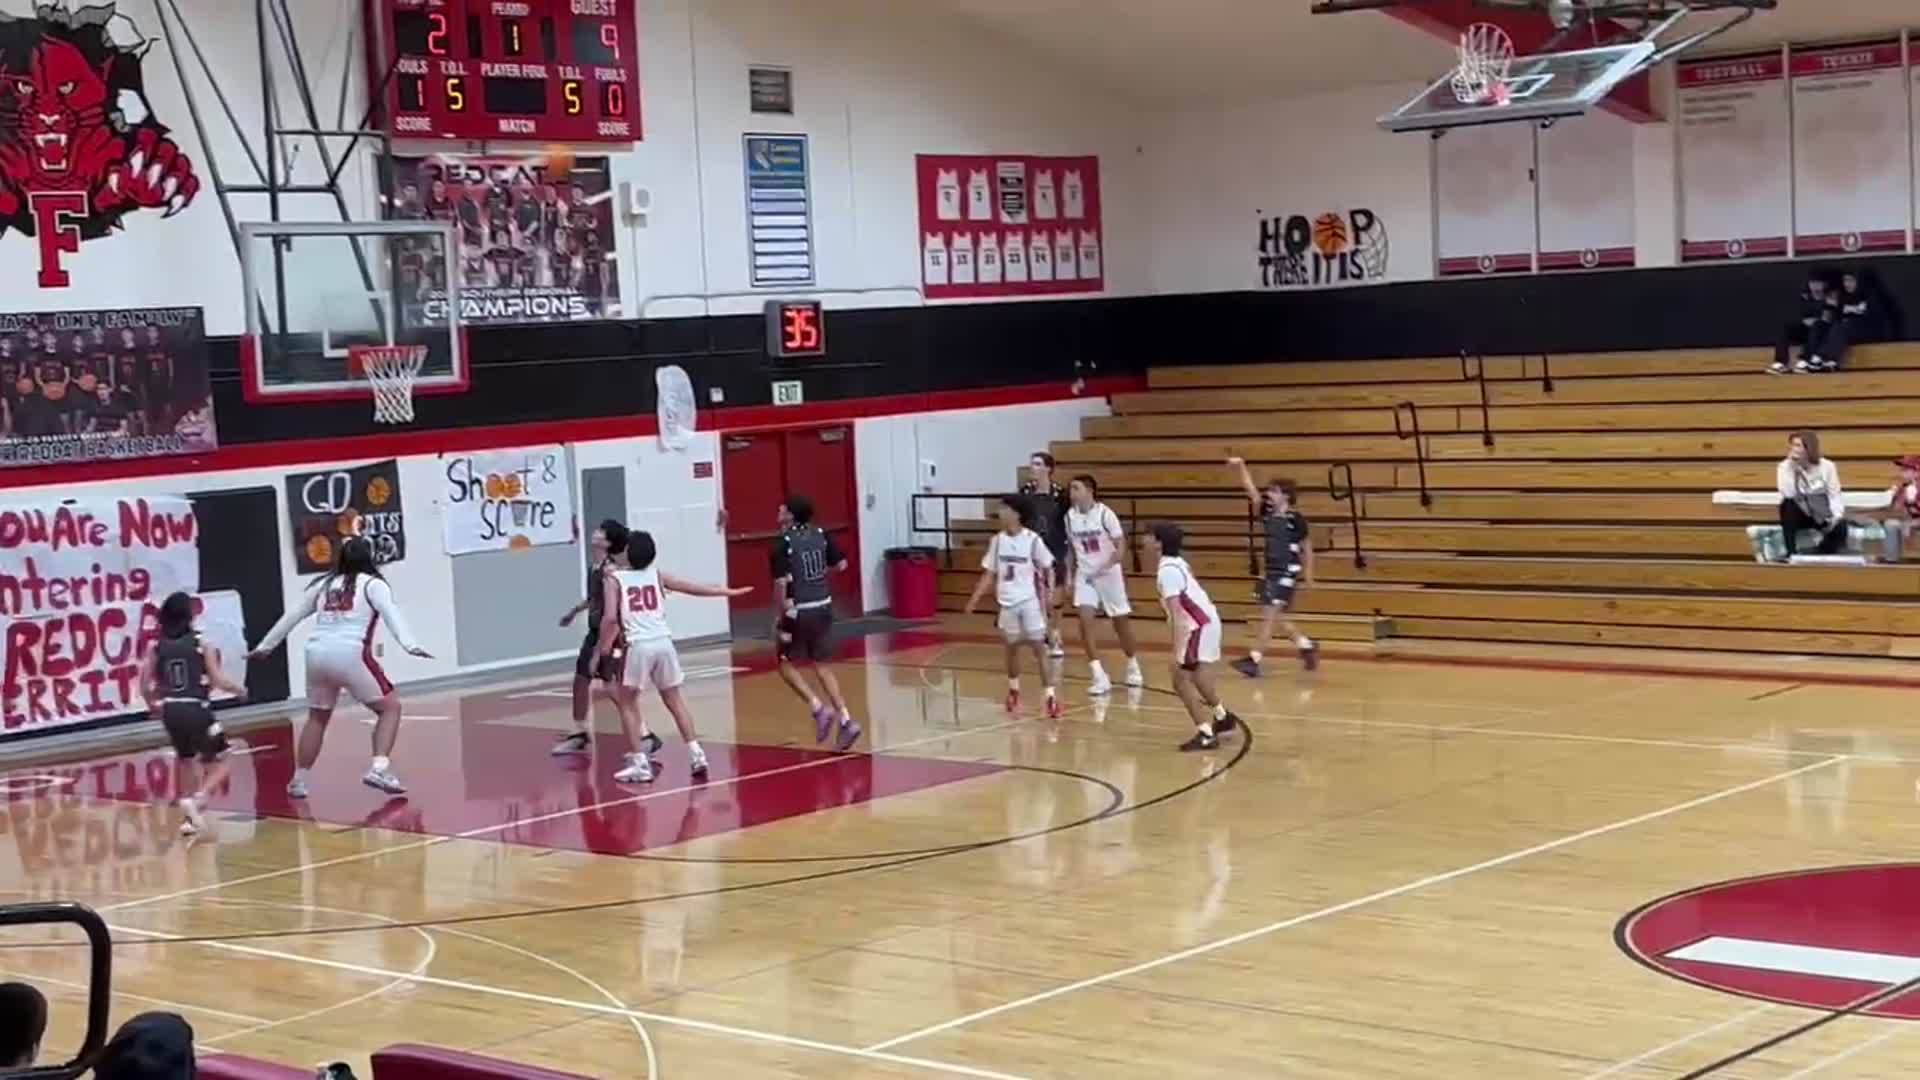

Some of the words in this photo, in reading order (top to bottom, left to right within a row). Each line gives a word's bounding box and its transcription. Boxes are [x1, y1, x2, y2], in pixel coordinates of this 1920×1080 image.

[572, 0, 617, 15] GUEST
[428, 14, 446, 54] 2
[512, 24, 519, 52] 1
[601, 24, 619, 61] 9
[395, 59, 429, 75] OULS
[416, 79, 424, 107] 1
[447, 78, 463, 110] 5
[565, 83, 580, 113] 5
[608, 85, 622, 115] 0
[396, 117, 432, 132] SCORE
[499, 119, 536, 133] MATCH
[29, 191, 88, 289] F
[784, 308, 818, 348] 35
[53, 506, 108, 551] Are
[118, 498, 194, 548] Now
[627, 584, 658, 612] 20
[4, 602, 204, 685] REDCA
